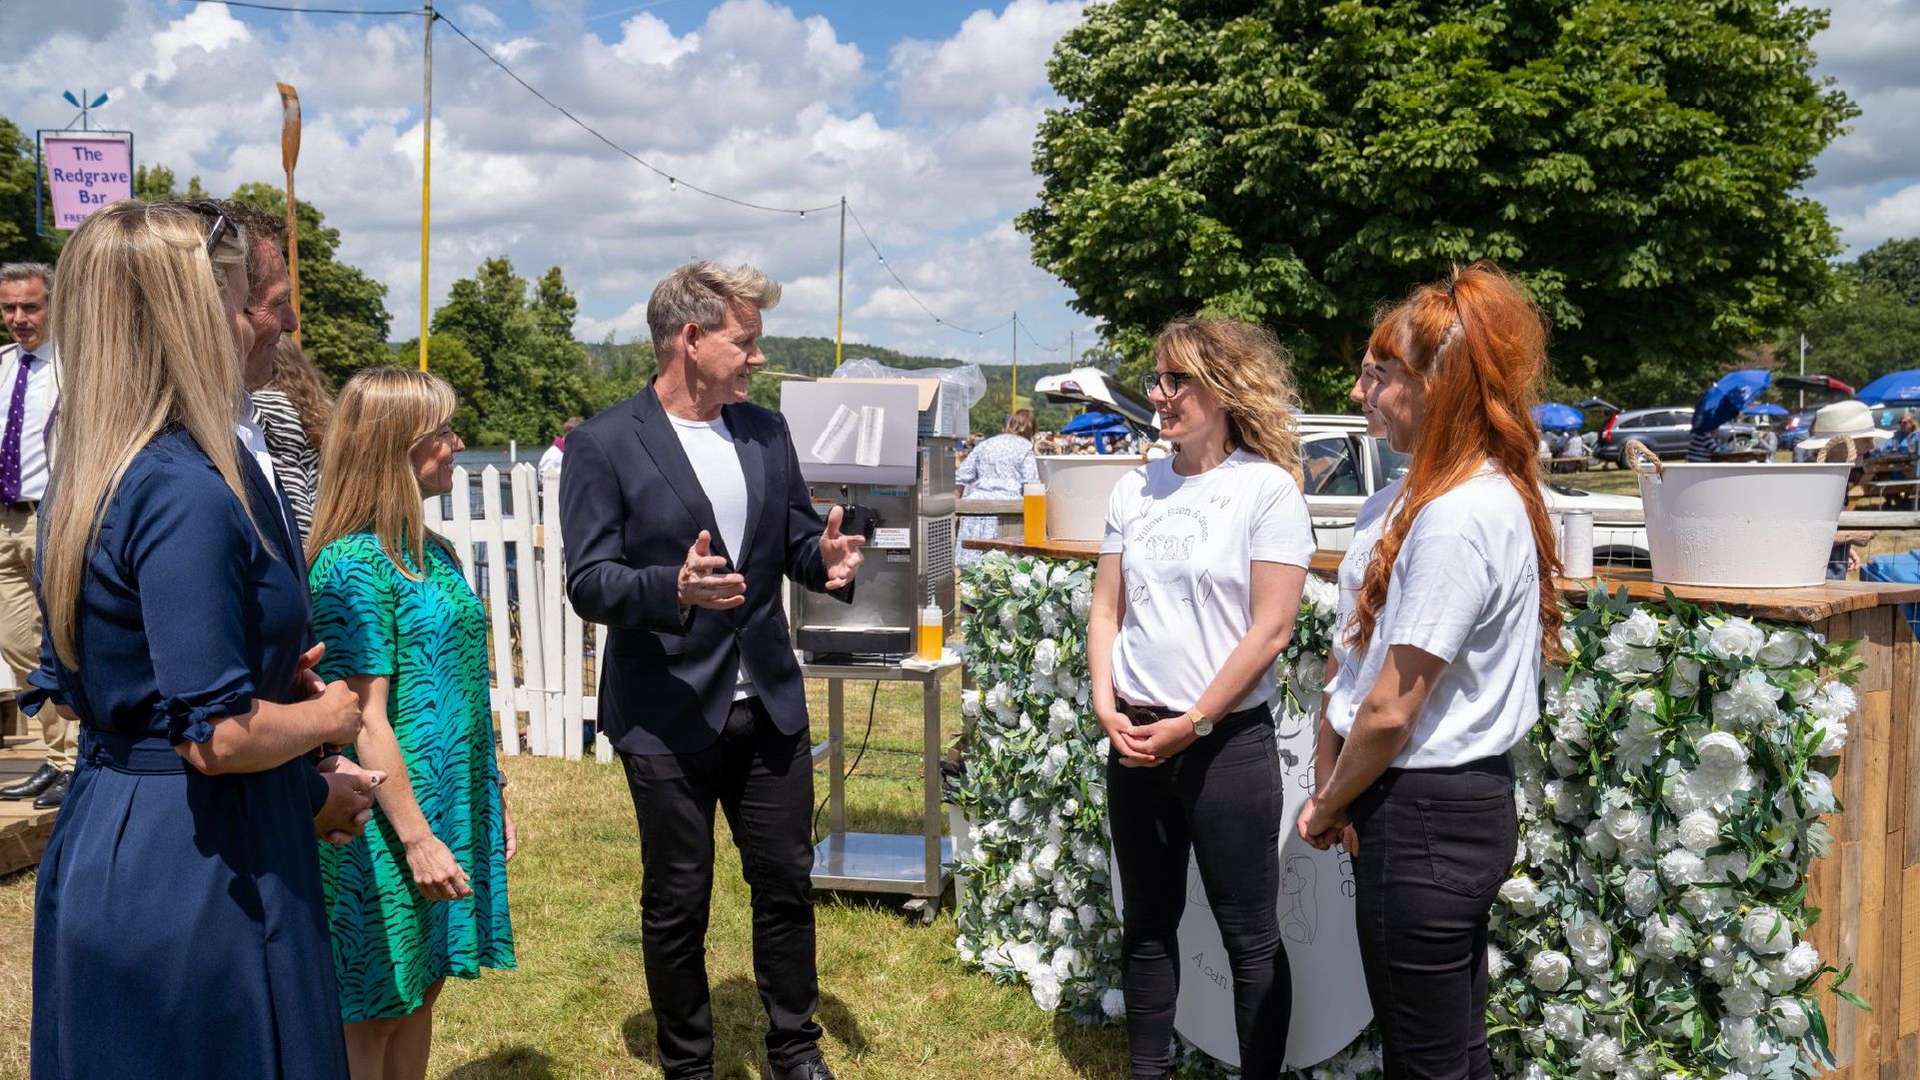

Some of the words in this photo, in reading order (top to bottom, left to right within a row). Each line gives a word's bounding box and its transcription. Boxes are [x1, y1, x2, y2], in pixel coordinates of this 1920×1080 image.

[73, 146, 103, 161] The
[53, 168, 128, 187] Redgrave
[79, 190, 107, 204] Bar
[1191, 951, 1204, 968] A
[1203, 966, 1232, 990] can
